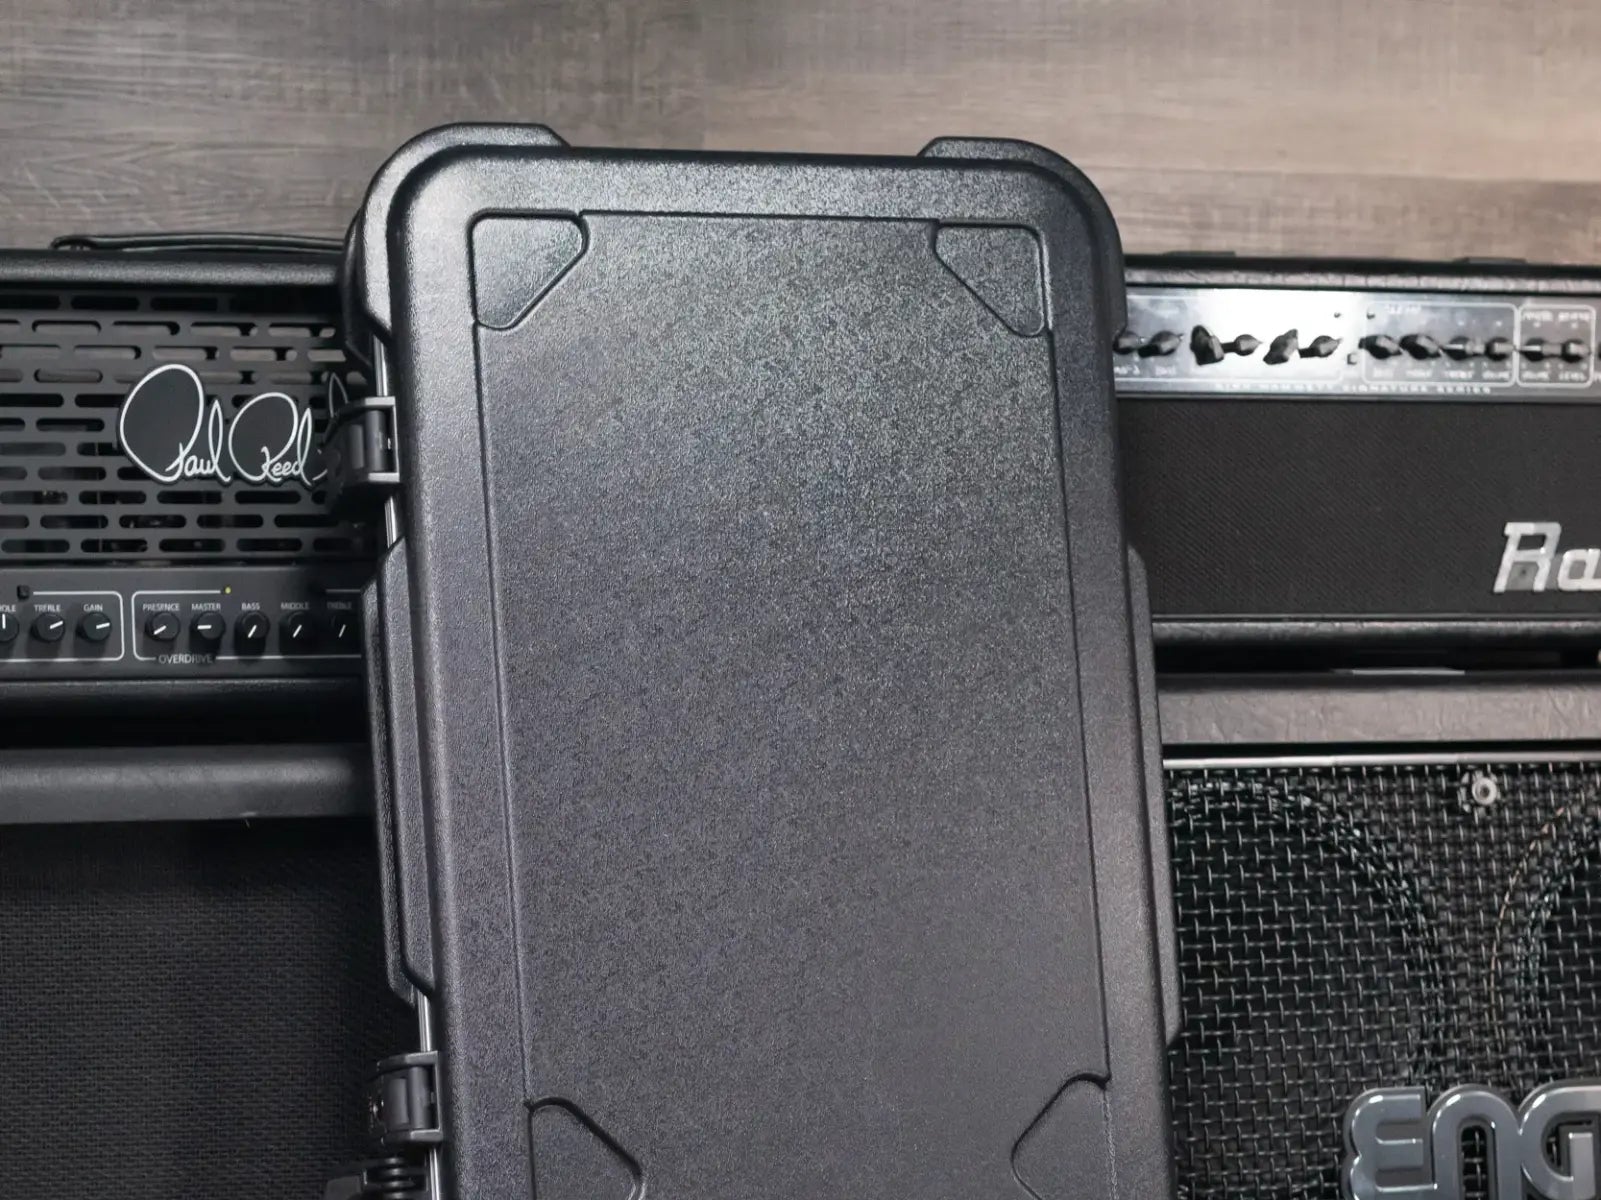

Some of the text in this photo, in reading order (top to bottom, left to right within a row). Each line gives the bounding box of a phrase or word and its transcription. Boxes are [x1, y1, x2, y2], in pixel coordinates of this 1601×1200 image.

[119, 363, 232, 483] Paul
[228, 391, 313, 487] Reed
[83, 603, 104, 612] GAIN
[142, 603, 180, 612] PRESENCE
[191, 602, 222, 611] MASTER
[241, 602, 261, 611] BASS
[280, 602, 310, 611] MIDDLE
[158, 653, 213, 665] OVERDRIVE
